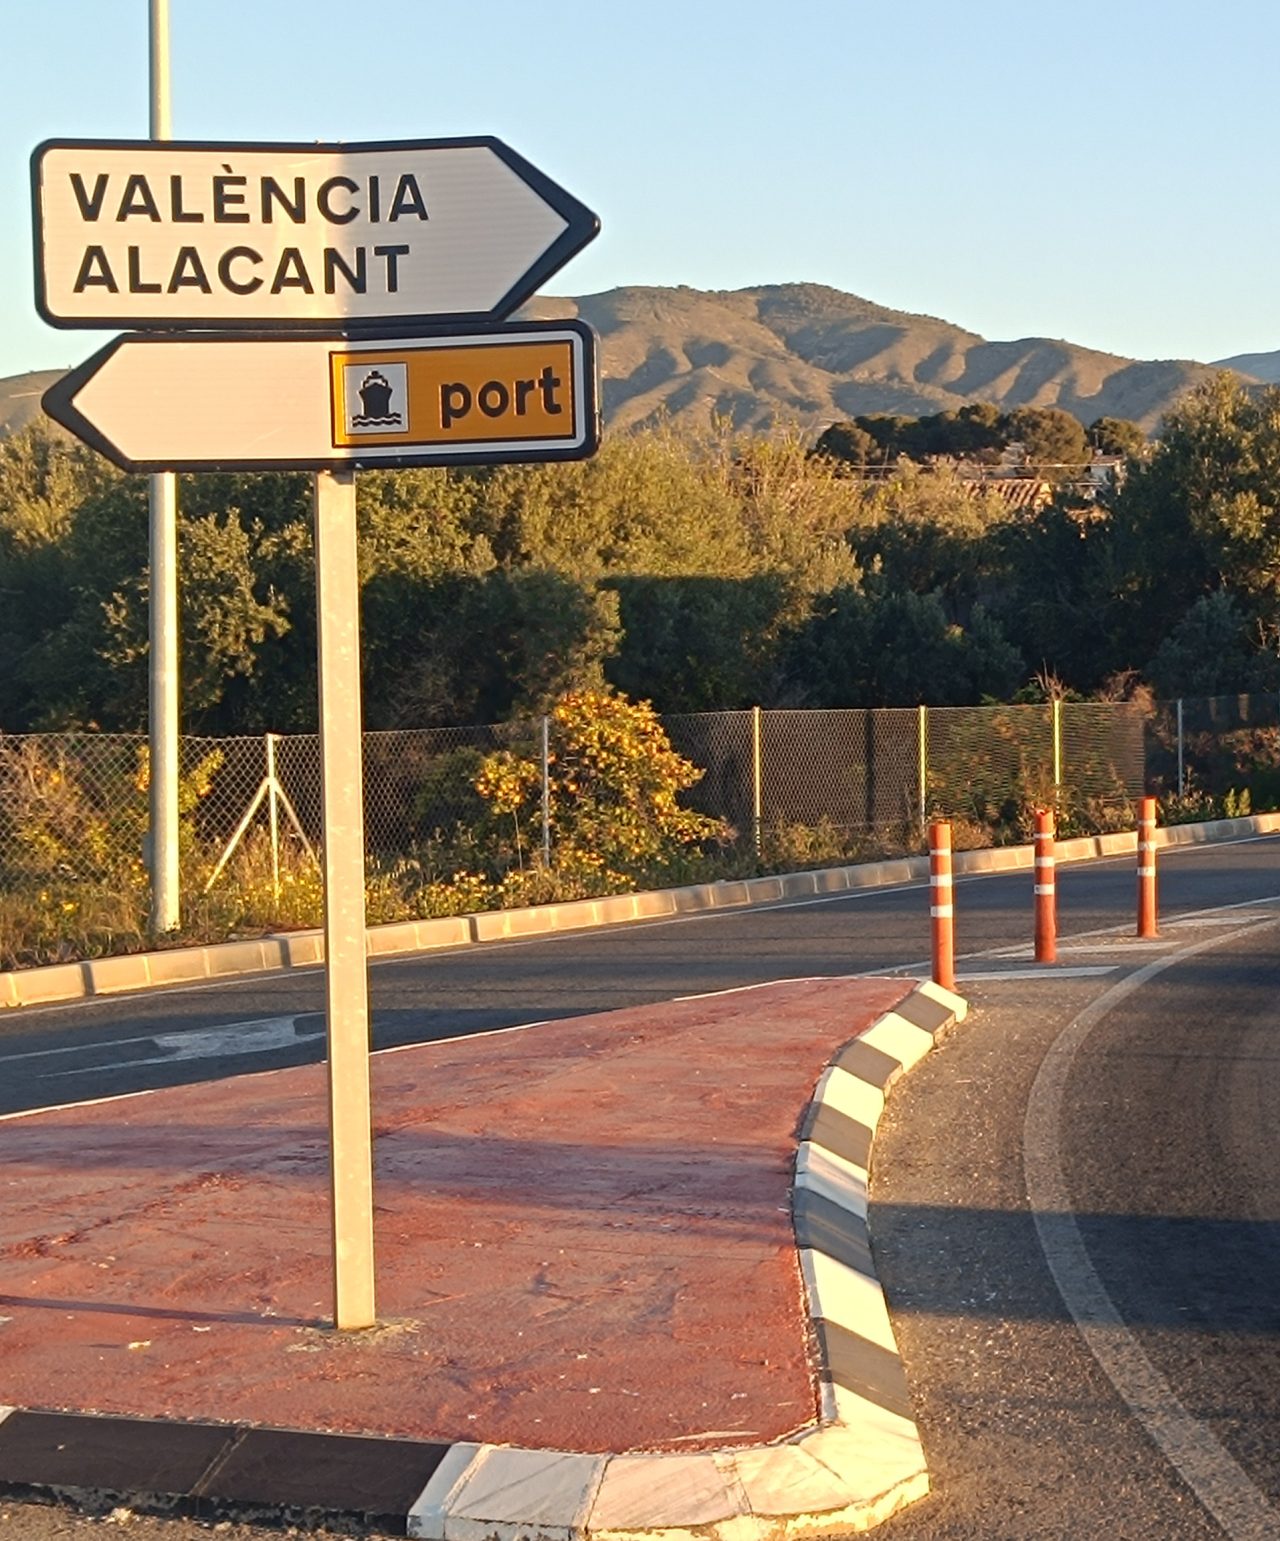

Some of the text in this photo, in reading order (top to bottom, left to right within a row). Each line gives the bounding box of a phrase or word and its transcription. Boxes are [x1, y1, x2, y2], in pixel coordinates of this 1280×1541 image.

[70, 164, 429, 225] VALÈNCIA
[73, 245, 410, 294] ALACANT
[440, 366, 563, 429] port
